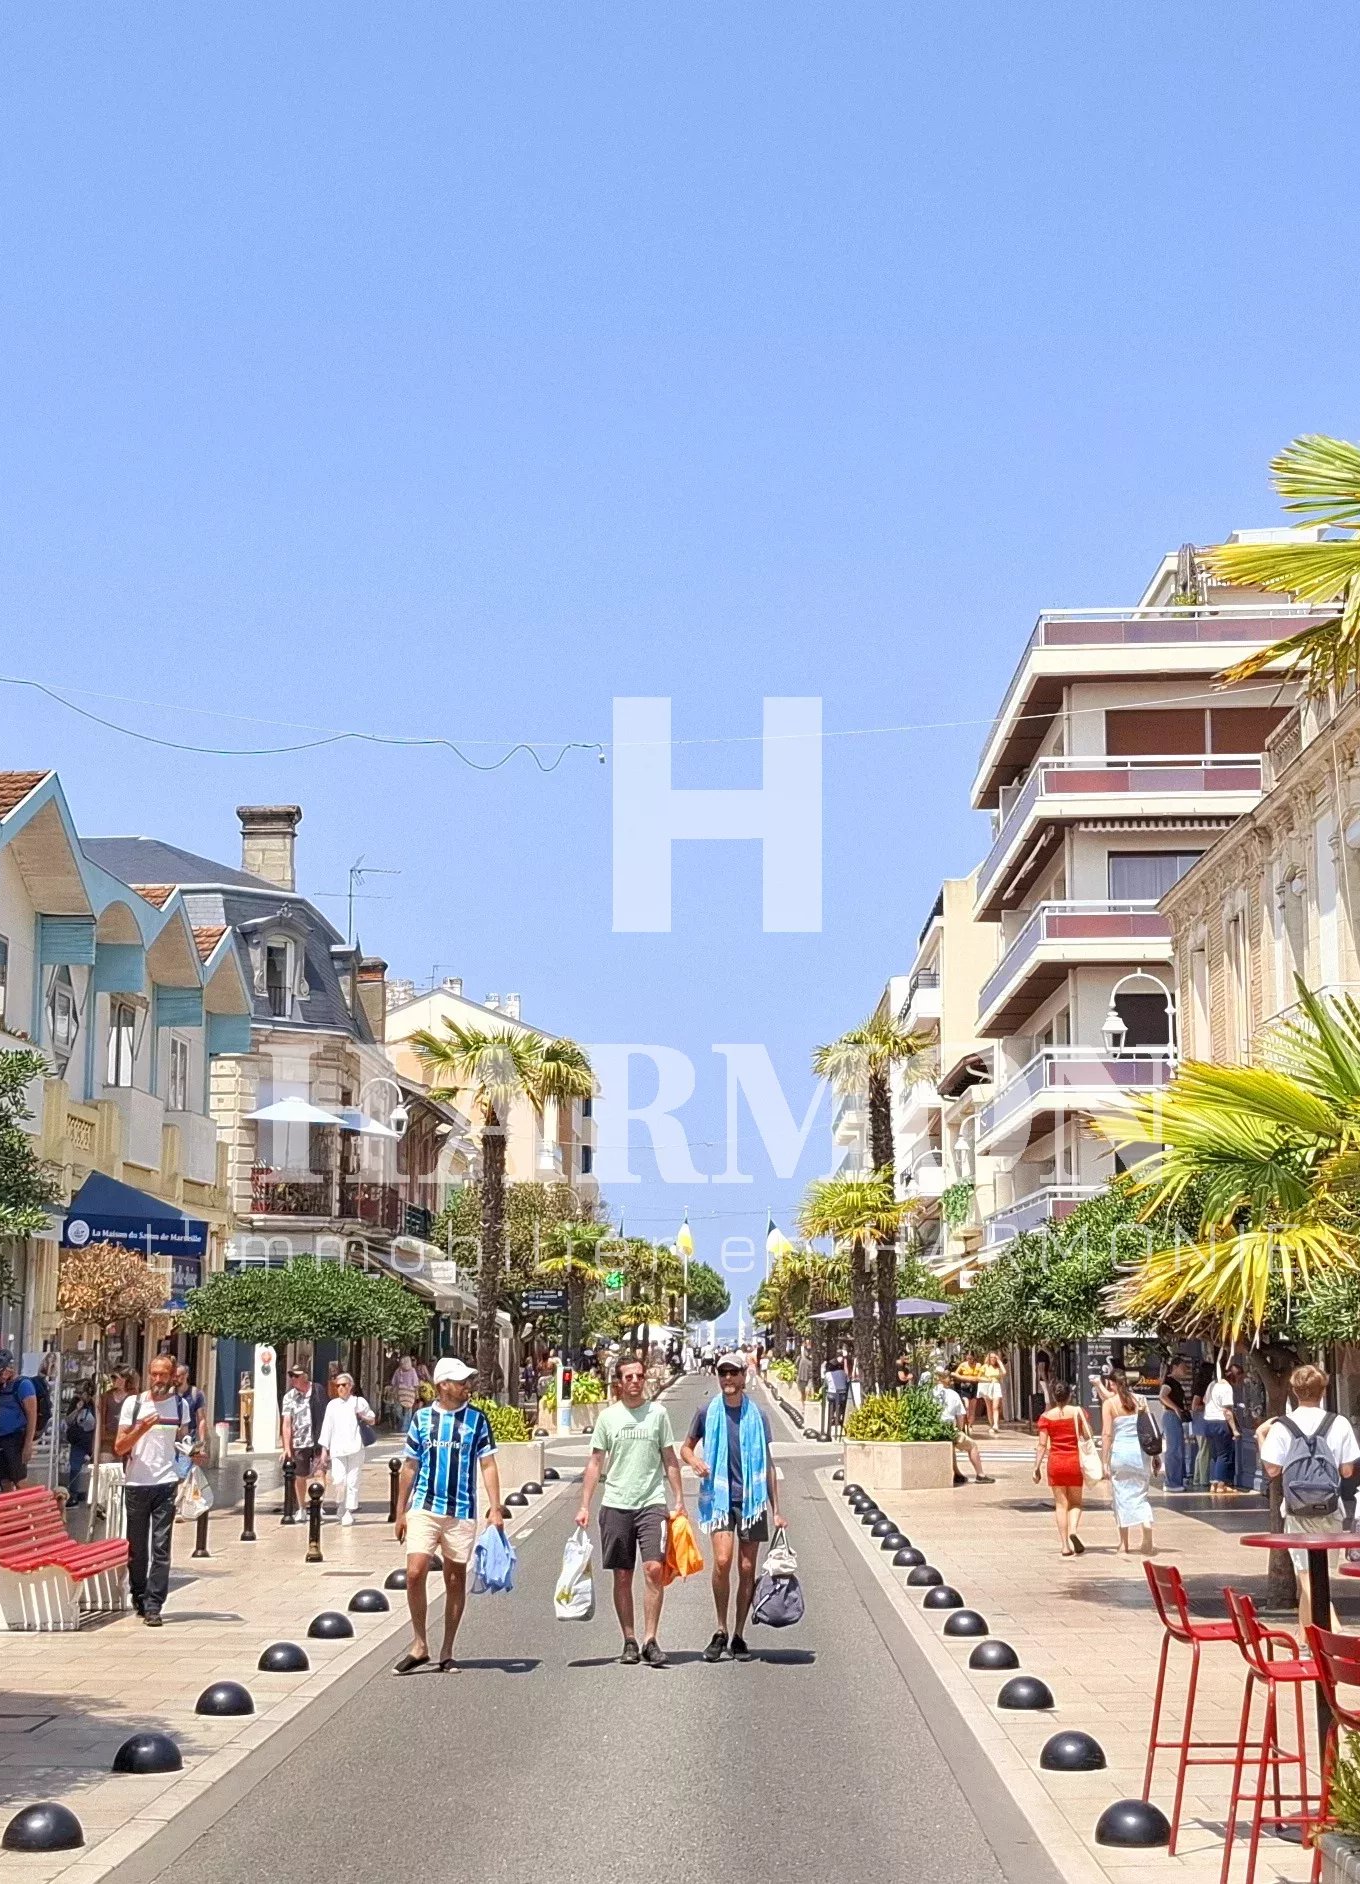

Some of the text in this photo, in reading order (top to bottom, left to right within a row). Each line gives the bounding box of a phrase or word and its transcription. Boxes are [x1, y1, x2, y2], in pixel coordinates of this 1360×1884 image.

[91, 1228, 202, 1243] La Maison du Savon de Marseille
